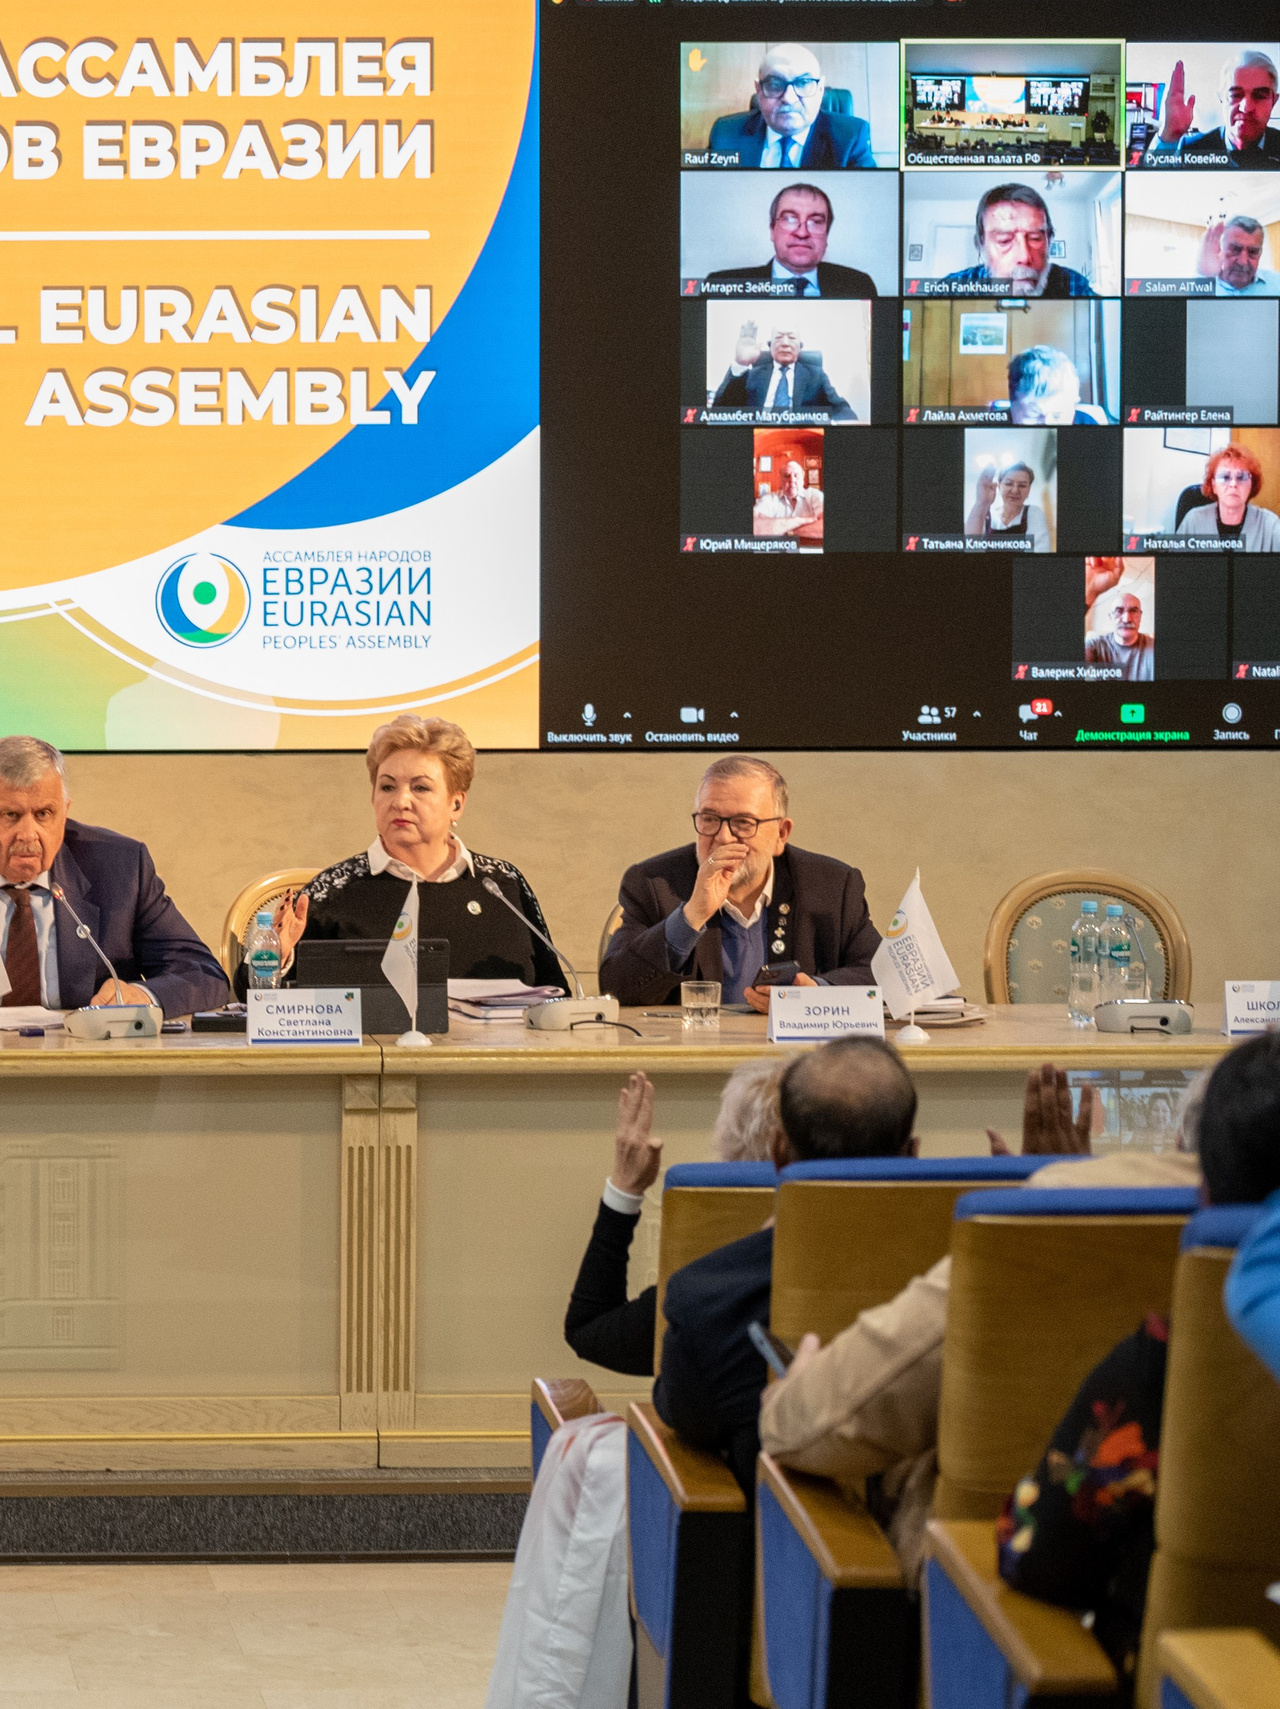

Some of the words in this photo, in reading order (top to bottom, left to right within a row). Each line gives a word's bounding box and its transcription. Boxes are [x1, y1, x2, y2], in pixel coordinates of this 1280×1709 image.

[83, 119, 434, 180] ЕВРАЗИИ
[685, 154, 708, 164] Rauf
[710, 154, 739, 165] Zeyni
[907, 153, 985, 164] Общественная
[987, 155, 1023, 164] палата
[1025, 153, 1041, 165] РФ
[1146, 153, 1183, 166] Руслан
[1184, 153, 1228, 164] Ковейко
[700, 281, 743, 294] Илгартс
[745, 281, 794, 295] Зейбертс
[924, 282, 950, 292] Erich
[951, 282, 1010, 293] Fankhauser
[1145, 281, 1177, 292] Salam
[40, 285, 432, 345] EURASIAN
[24, 367, 436, 427] ASSEMBLY
[700, 409, 754, 422] Алмамбет
[755, 409, 829, 423] Матубраимов
[922, 409, 956, 421] Лайла
[957, 409, 1008, 421] Ахметова
[1144, 409, 1199, 423] Райтингер
[1200, 410, 1231, 421] Елена
[700, 538, 732, 551] Юрий
[733, 539, 797, 551] Мищеряков
[922, 538, 963, 549] Татьяна
[965, 538, 1031, 549] Ключникова
[1143, 537, 1186, 549] Наталья
[1187, 538, 1243, 549] Степанова
[263, 551, 353, 563] АССАМБЛЕЯ
[358, 550, 432, 564] НАРОДОВ
[262, 567, 431, 596] ЕВРАЗИИ
[262, 600, 431, 627] EURASIAN
[262, 635, 342, 649] PEOPLES'
[346, 635, 432, 649] ASSEMBLY
[1031, 666, 1075, 679] Валерик
[1252, 665, 1280, 678] Natal
[944, 706, 957, 718] 57
[1035, 702, 1048, 713] 21
[547, 731, 607, 743] Выключить
[608, 733, 633, 745] звук
[645, 731, 706, 743] Остановить
[706, 732, 739, 744] видео
[902, 730, 957, 741] Участники
[1019, 730, 1038, 741] Чат
[1075, 729, 1152, 742] Демонстрация
[1153, 730, 1190, 742] экрана
[1213, 729, 1250, 741] Запись
[893, 940, 921, 994] EURASIAN
[902, 936, 930, 989] ЕВРАЗИИ
[266, 1004, 343, 1014] СМИРНОВА
[804, 1006, 850, 1016] ЗОРИН
[278, 1018, 331, 1026] Светлана
[779, 1020, 830, 1031] Владимир
[832, 1020, 878, 1031] Юрьевич
[257, 1028, 353, 1036] Константиновна
